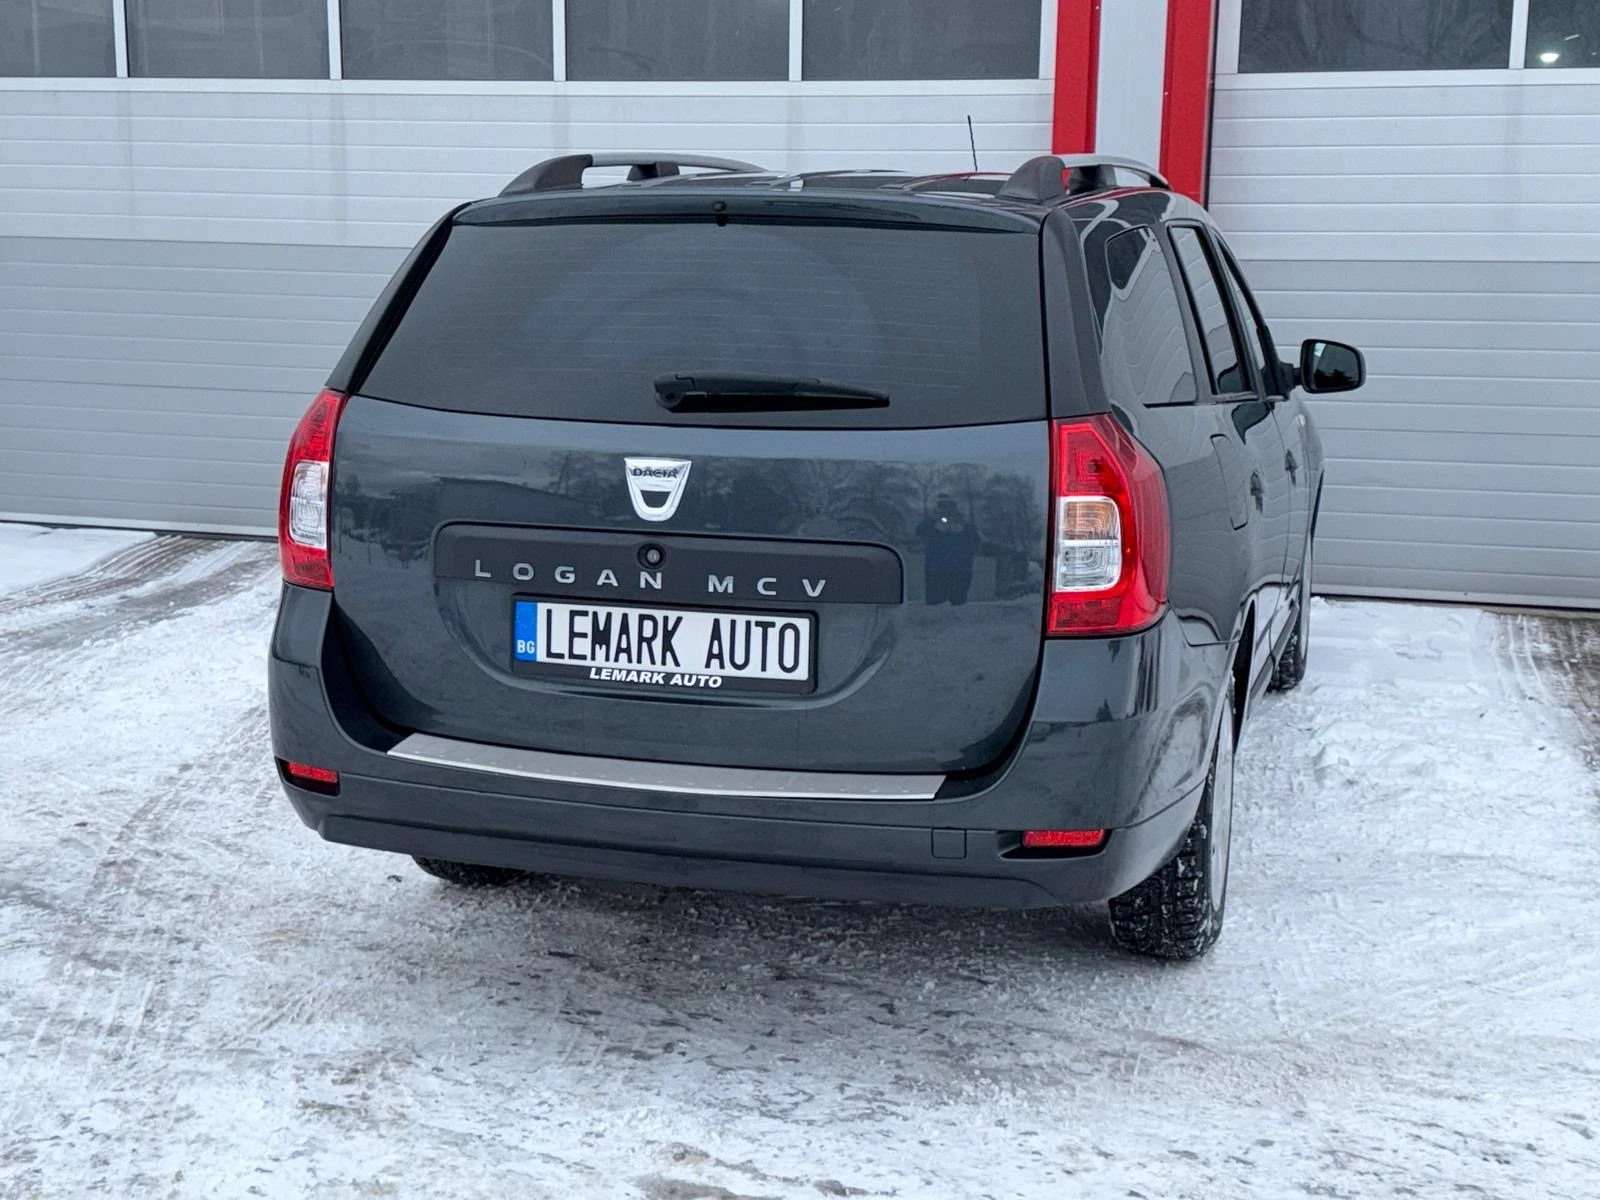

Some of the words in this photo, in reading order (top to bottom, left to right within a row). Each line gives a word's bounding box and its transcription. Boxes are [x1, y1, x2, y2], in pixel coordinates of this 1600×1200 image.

[632, 467, 679, 479] DACIA
[474, 559, 662, 590] LOGAN
[708, 574, 827, 597] MCV
[517, 639, 535, 654] BG
[545, 608, 683, 668] LEMARK
[704, 618, 801, 674] AUTO
[589, 667, 665, 685] LEMARK
[669, 673, 723, 689] AUTO
